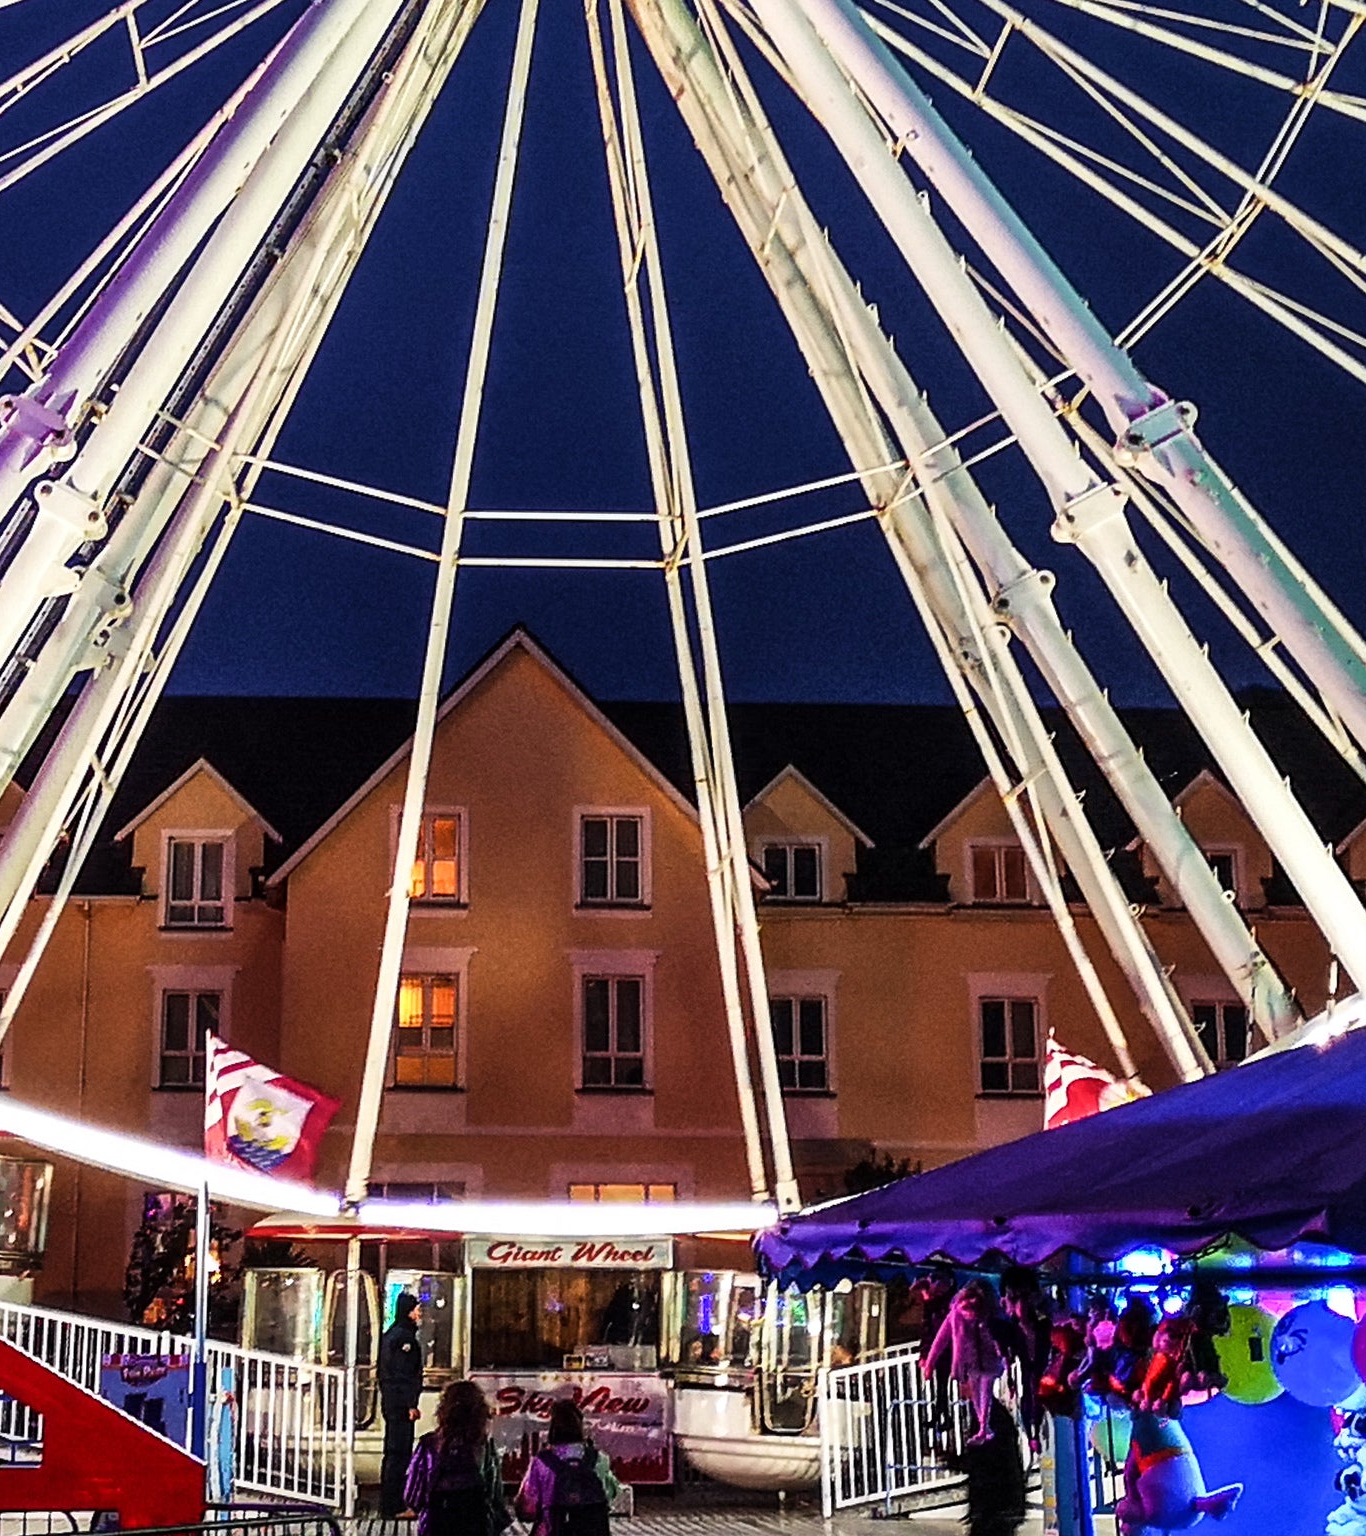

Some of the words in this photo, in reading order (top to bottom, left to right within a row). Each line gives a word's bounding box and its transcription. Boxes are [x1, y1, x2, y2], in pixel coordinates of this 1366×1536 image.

[486, 1240, 564, 1264] Giant
[570, 1241, 655, 1263] Wheel
[494, 1386, 553, 1419] Sky
[572, 1386, 651, 1414] View
